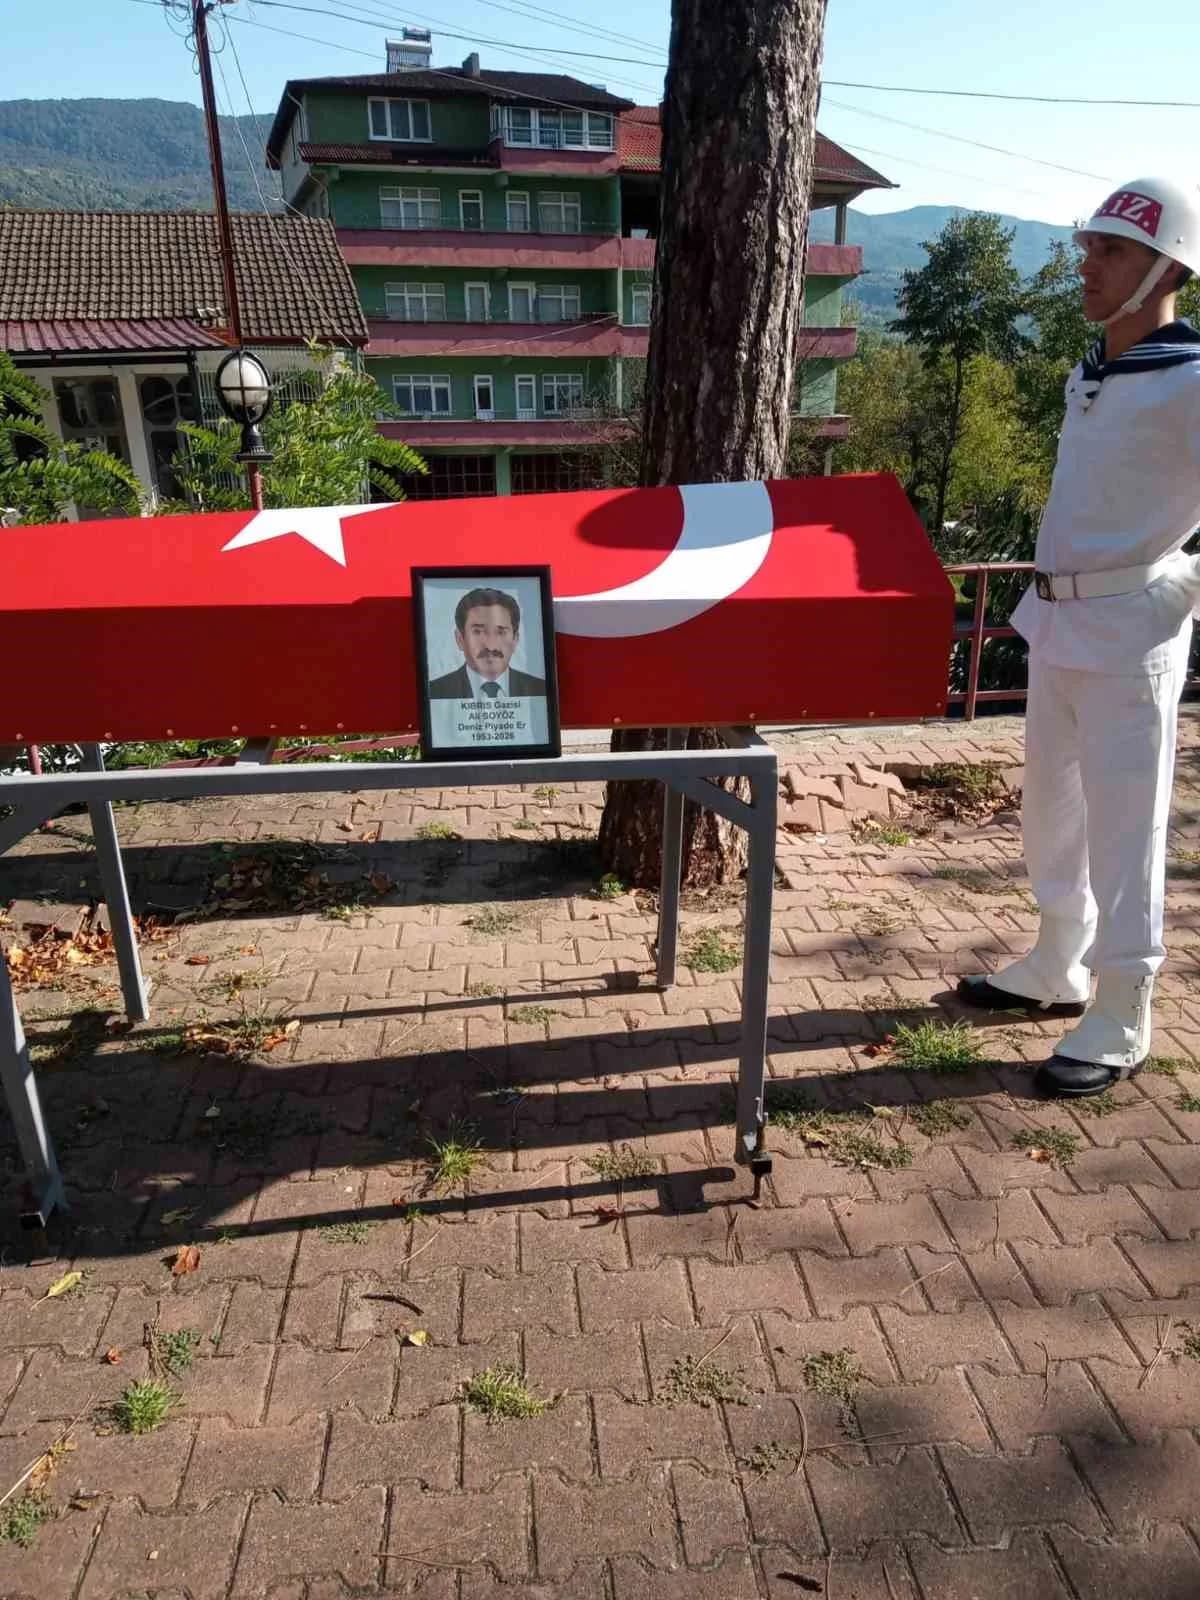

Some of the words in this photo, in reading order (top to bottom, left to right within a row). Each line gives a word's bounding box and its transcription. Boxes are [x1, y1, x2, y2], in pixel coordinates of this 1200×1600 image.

[461, 701, 492, 710] KIBRIS
[458, 723, 483, 731] Deniz
[485, 721, 514, 731] Piyade
